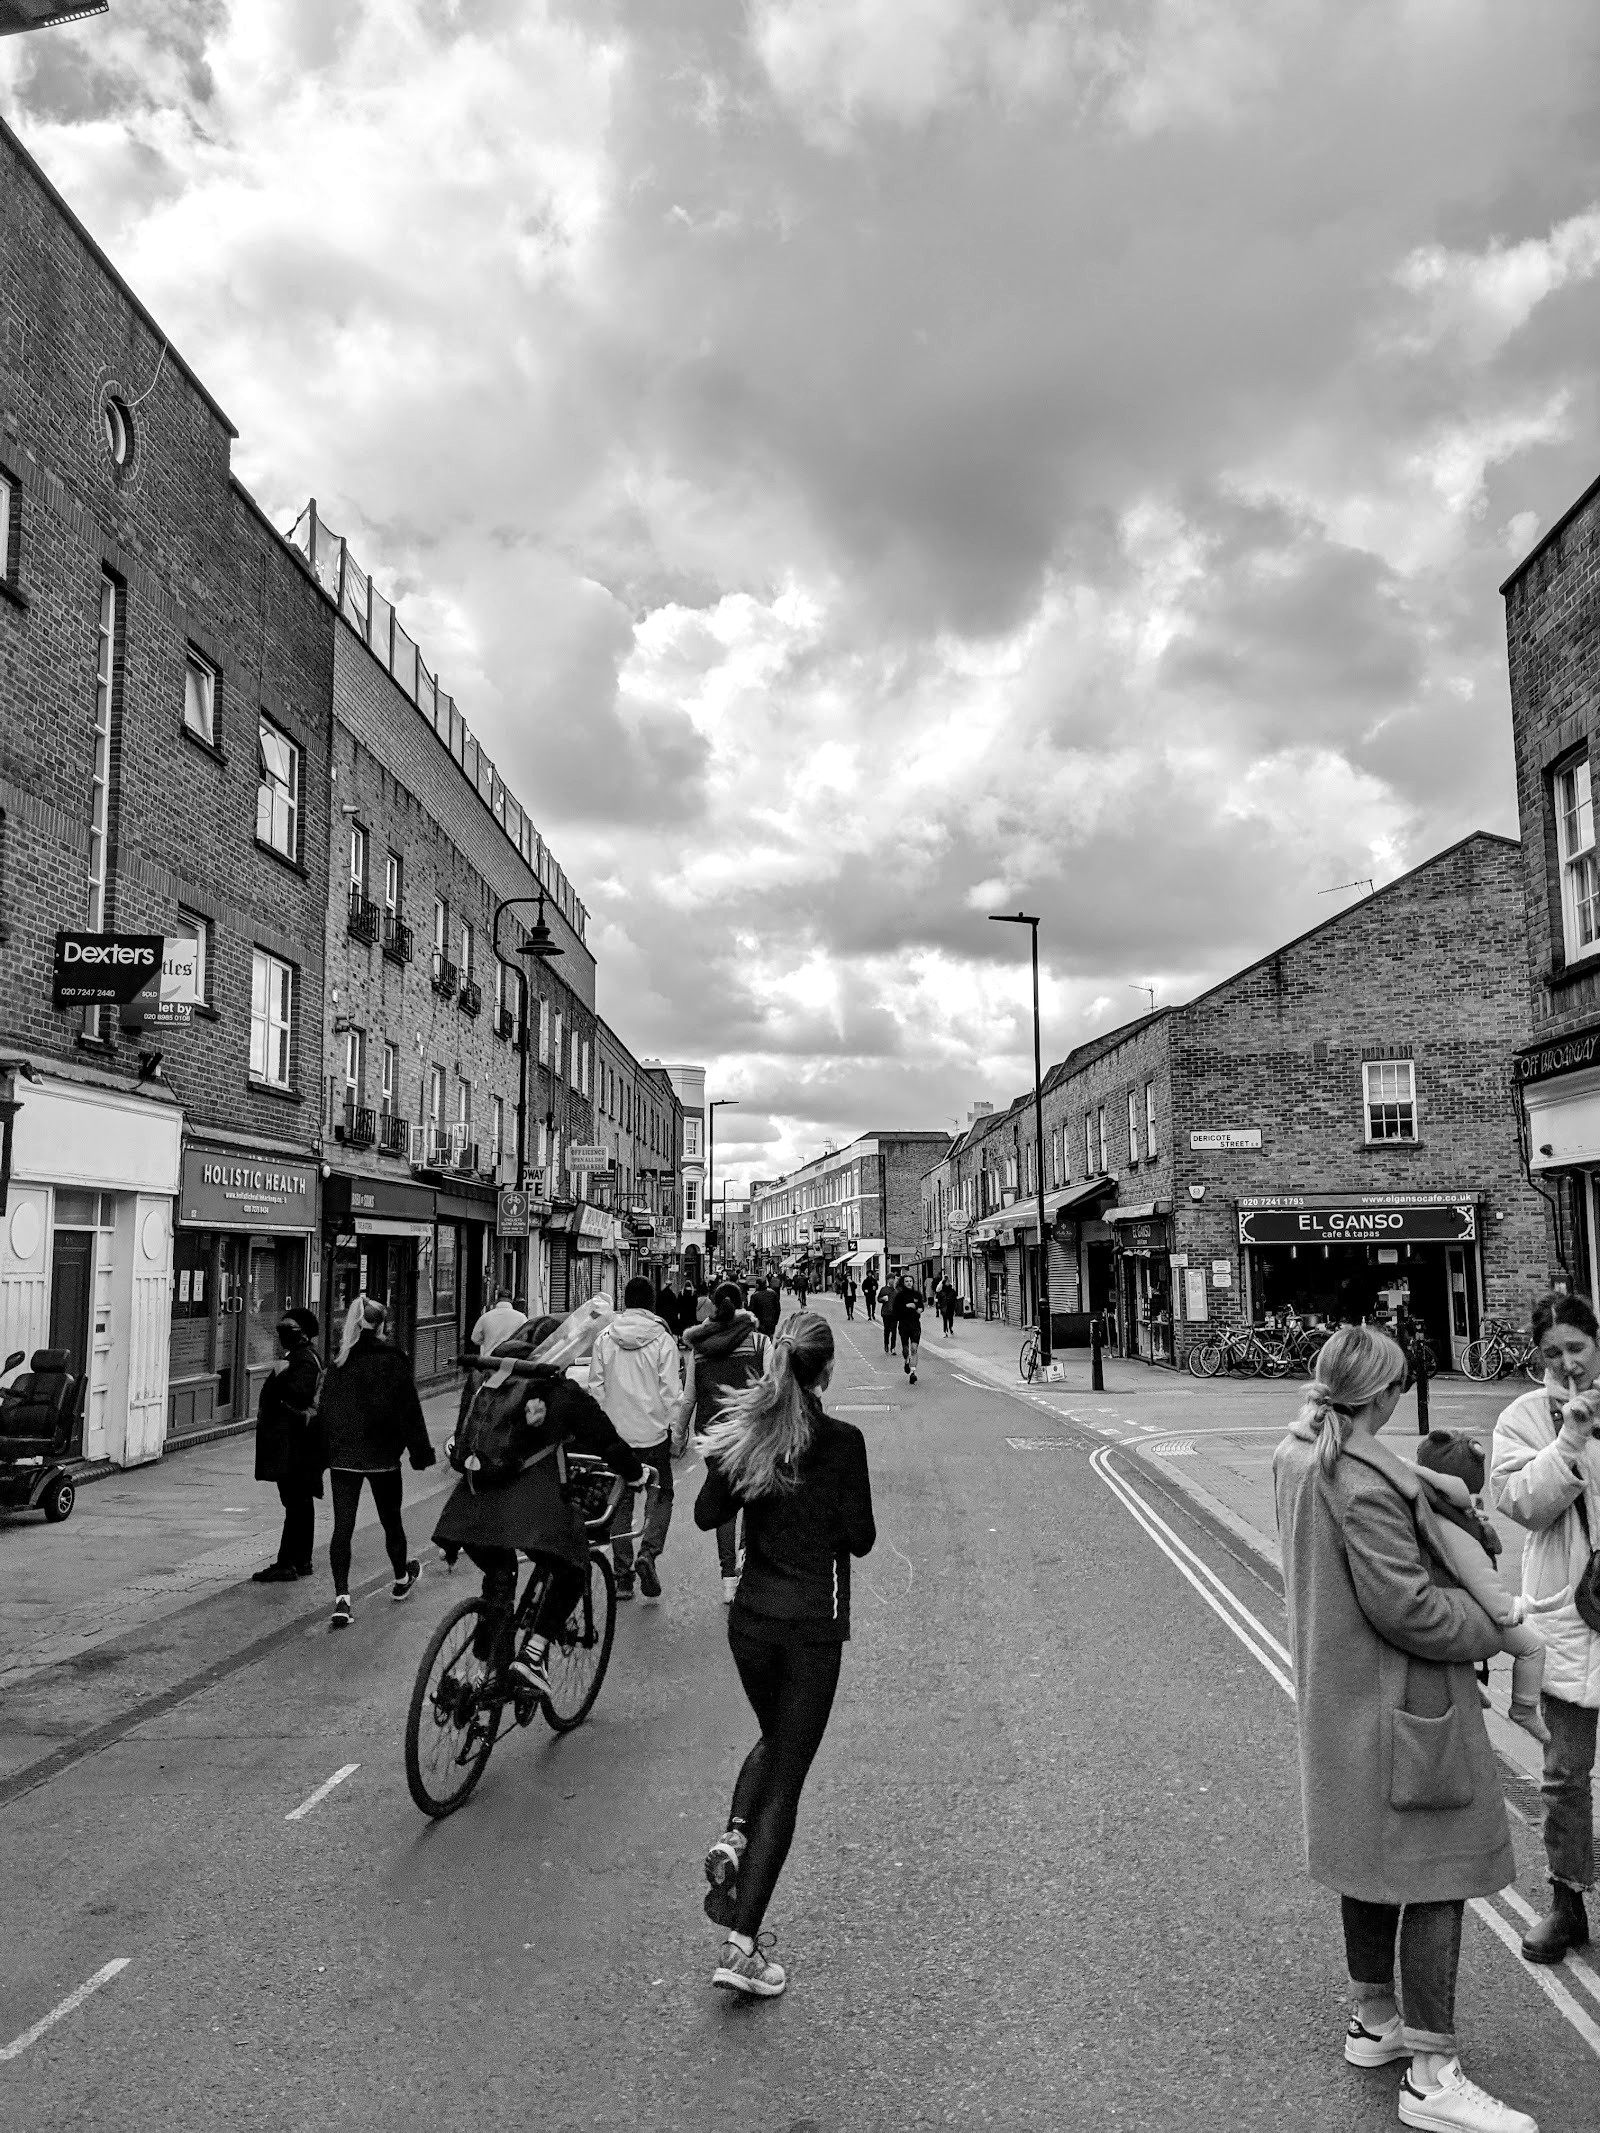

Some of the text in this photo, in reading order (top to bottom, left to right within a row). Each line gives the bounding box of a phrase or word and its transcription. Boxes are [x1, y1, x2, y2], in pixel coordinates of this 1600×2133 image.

[63, 941, 155, 965] Dexters
[162, 959, 193, 976] tles
[61, 987, 116, 998] 020 7247 2440
[158, 1002, 192, 1015] let by
[1520, 1036, 1599, 1078] OFF BROADWAY
[1193, 1134, 1231, 1142] DERICOTE
[1220, 1140, 1250, 1148] STREET
[203, 1163, 306, 1195] HOLISTIC HEALTH
[523, 1169, 545, 1180] DWAY
[525, 1182, 544, 1197] FE
[1242, 1196, 1304, 1206] 020 7241 1793
[1361, 1192, 1472, 1204] www.elgansocafe.co.uk
[1298, 1213, 1404, 1231] EL GANSO
[1321, 1229, 1380, 1239] cafe & tapas
